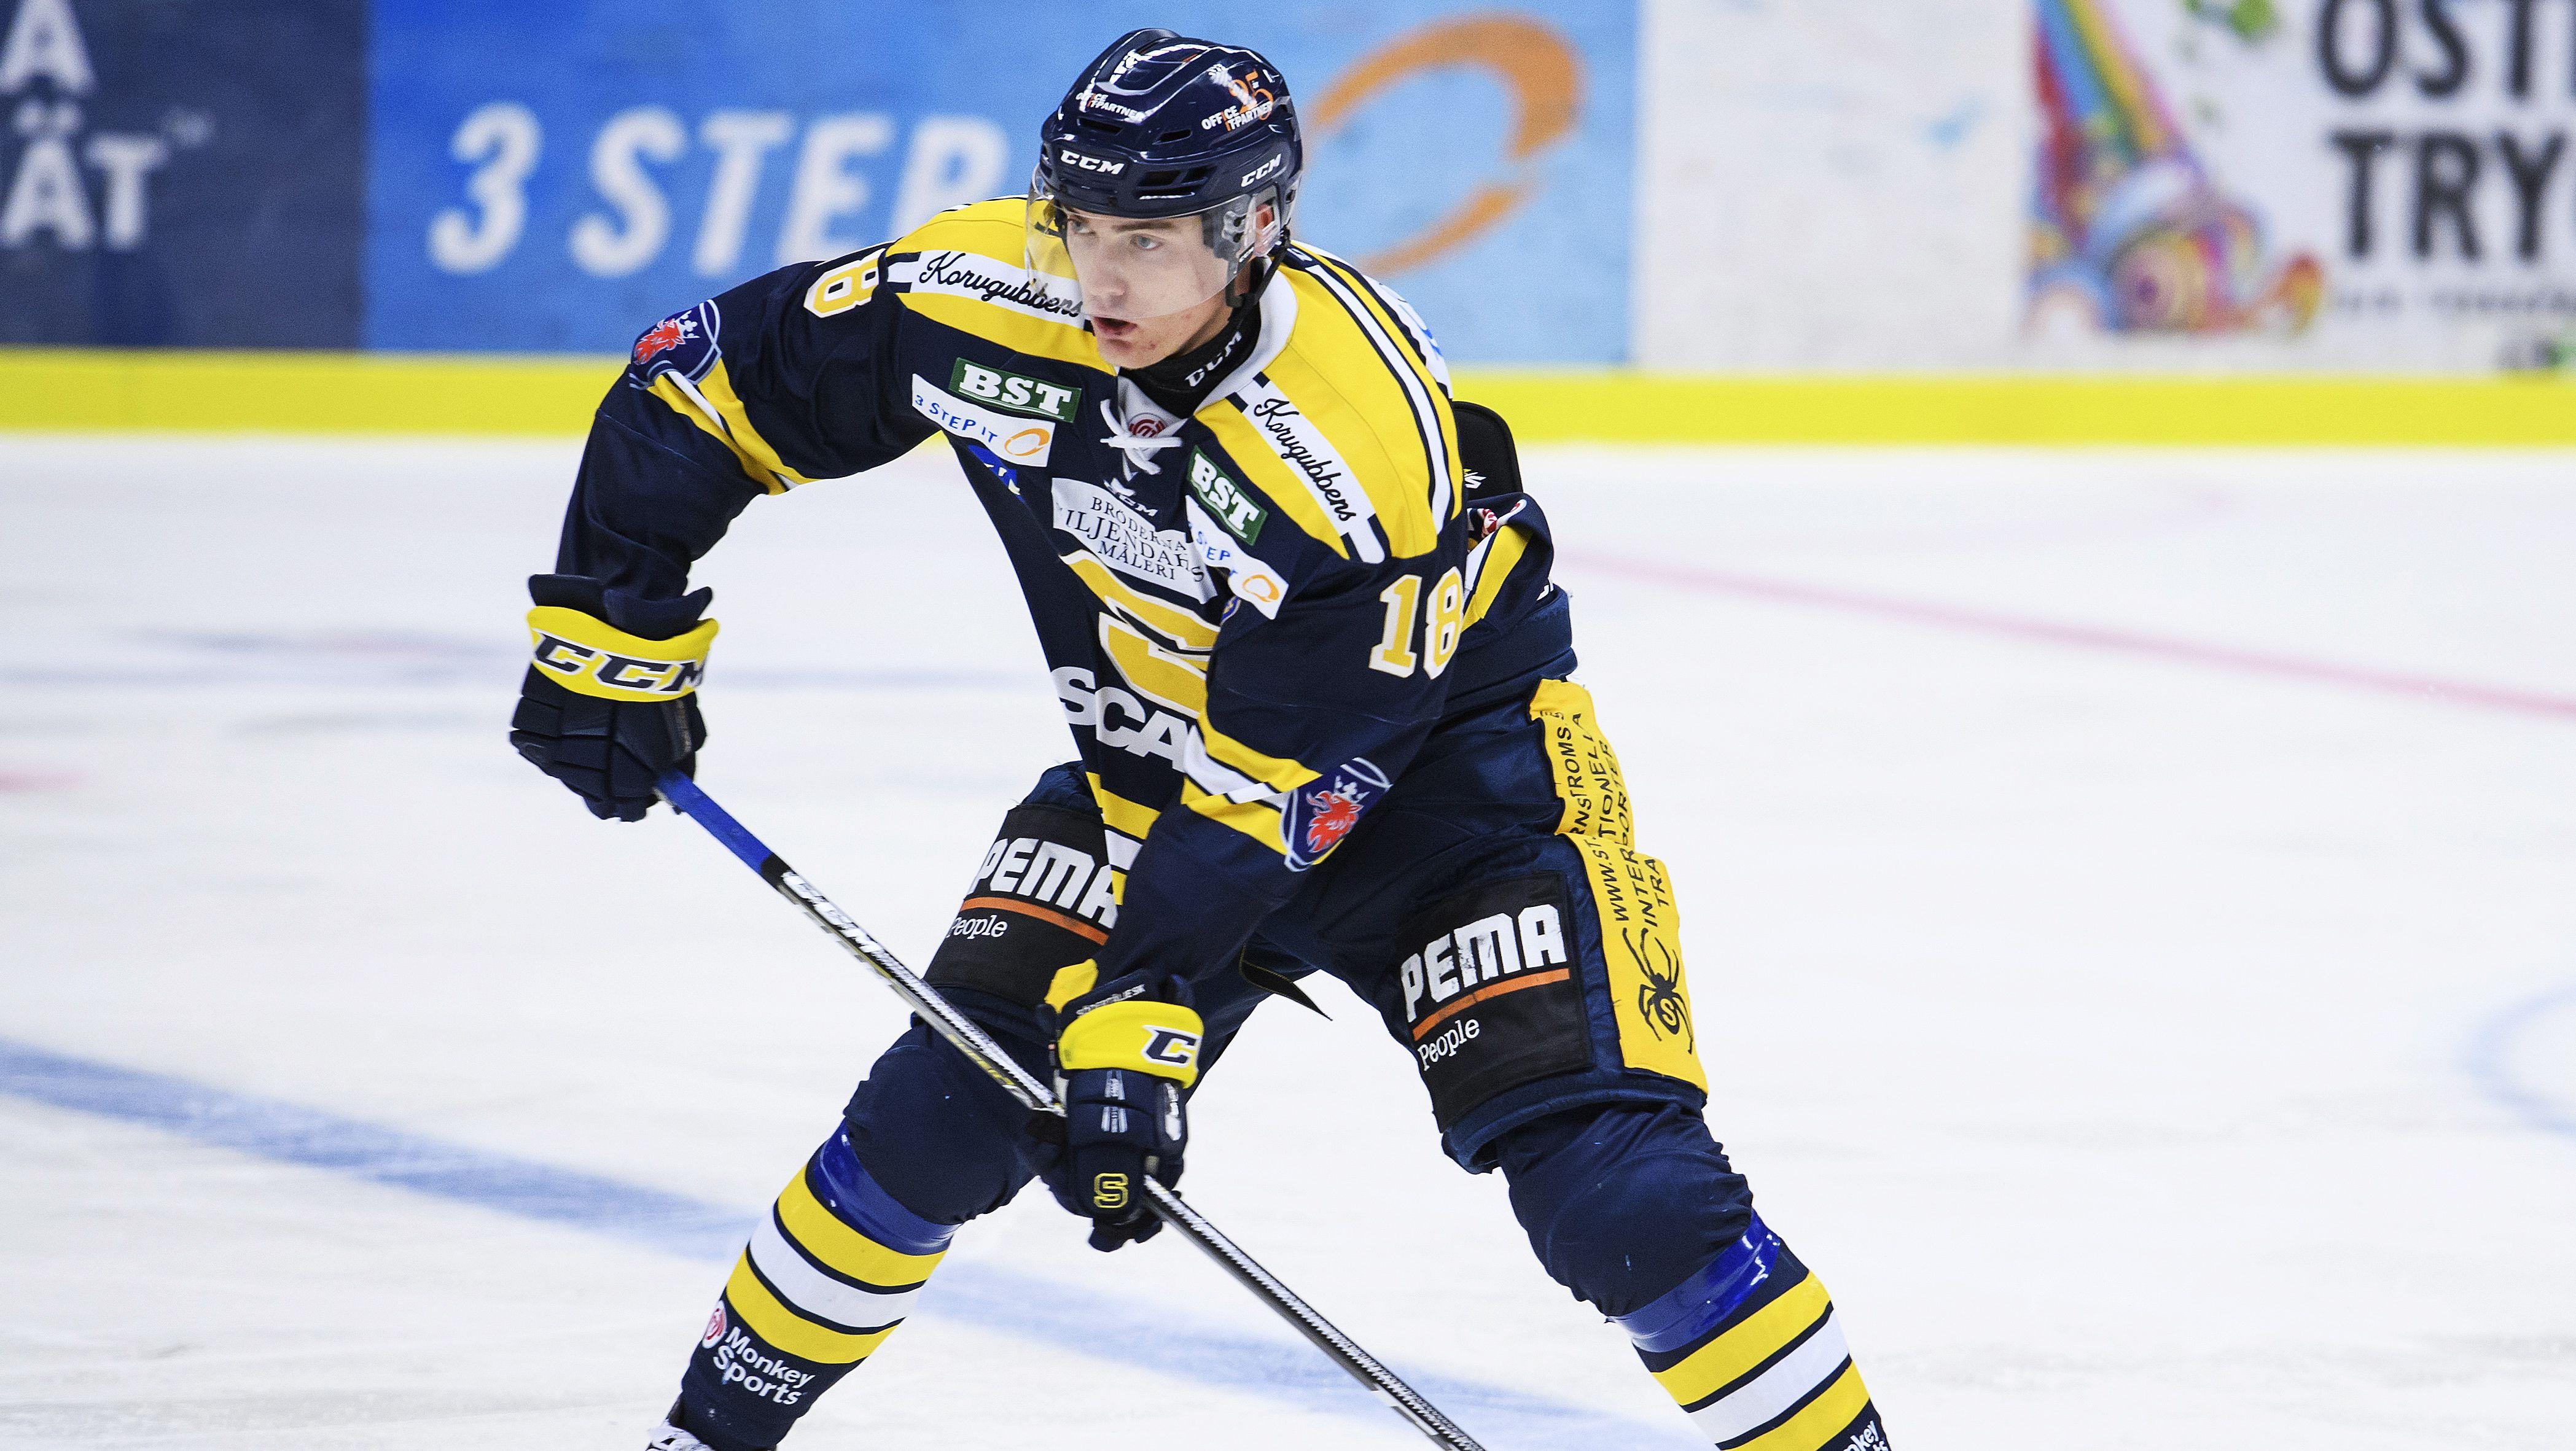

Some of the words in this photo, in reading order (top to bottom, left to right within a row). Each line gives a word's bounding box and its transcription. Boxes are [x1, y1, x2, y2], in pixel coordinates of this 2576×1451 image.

[1201, 105, 1239, 130] OFFICE
[428, 101, 543, 274] 3
[569, 104, 1009, 276] STEP
[1060, 149, 1125, 175] CCM
[1241, 153, 1282, 187] CCM
[919, 251, 1083, 317] Korvgubbens
[915, 395, 924, 407] 3
[929, 402, 977, 431] STEP
[982, 427, 997, 443] IT
[959, 364, 1072, 415] BST
[1254, 398, 1357, 521] Korvgubbens
[1192, 453, 1260, 531] BST
[1098, 540, 1176, 580] MÅLERI
[1368, 566, 1465, 680] 18
[533, 628, 706, 694] CCM
[966, 838, 1118, 928] PEMA
[1401, 904, 1567, 1022] PEMA
[1418, 1019, 1480, 1071] People
[714, 1345, 803, 1405] Sports
[725, 1326, 816, 1388] Monkey
